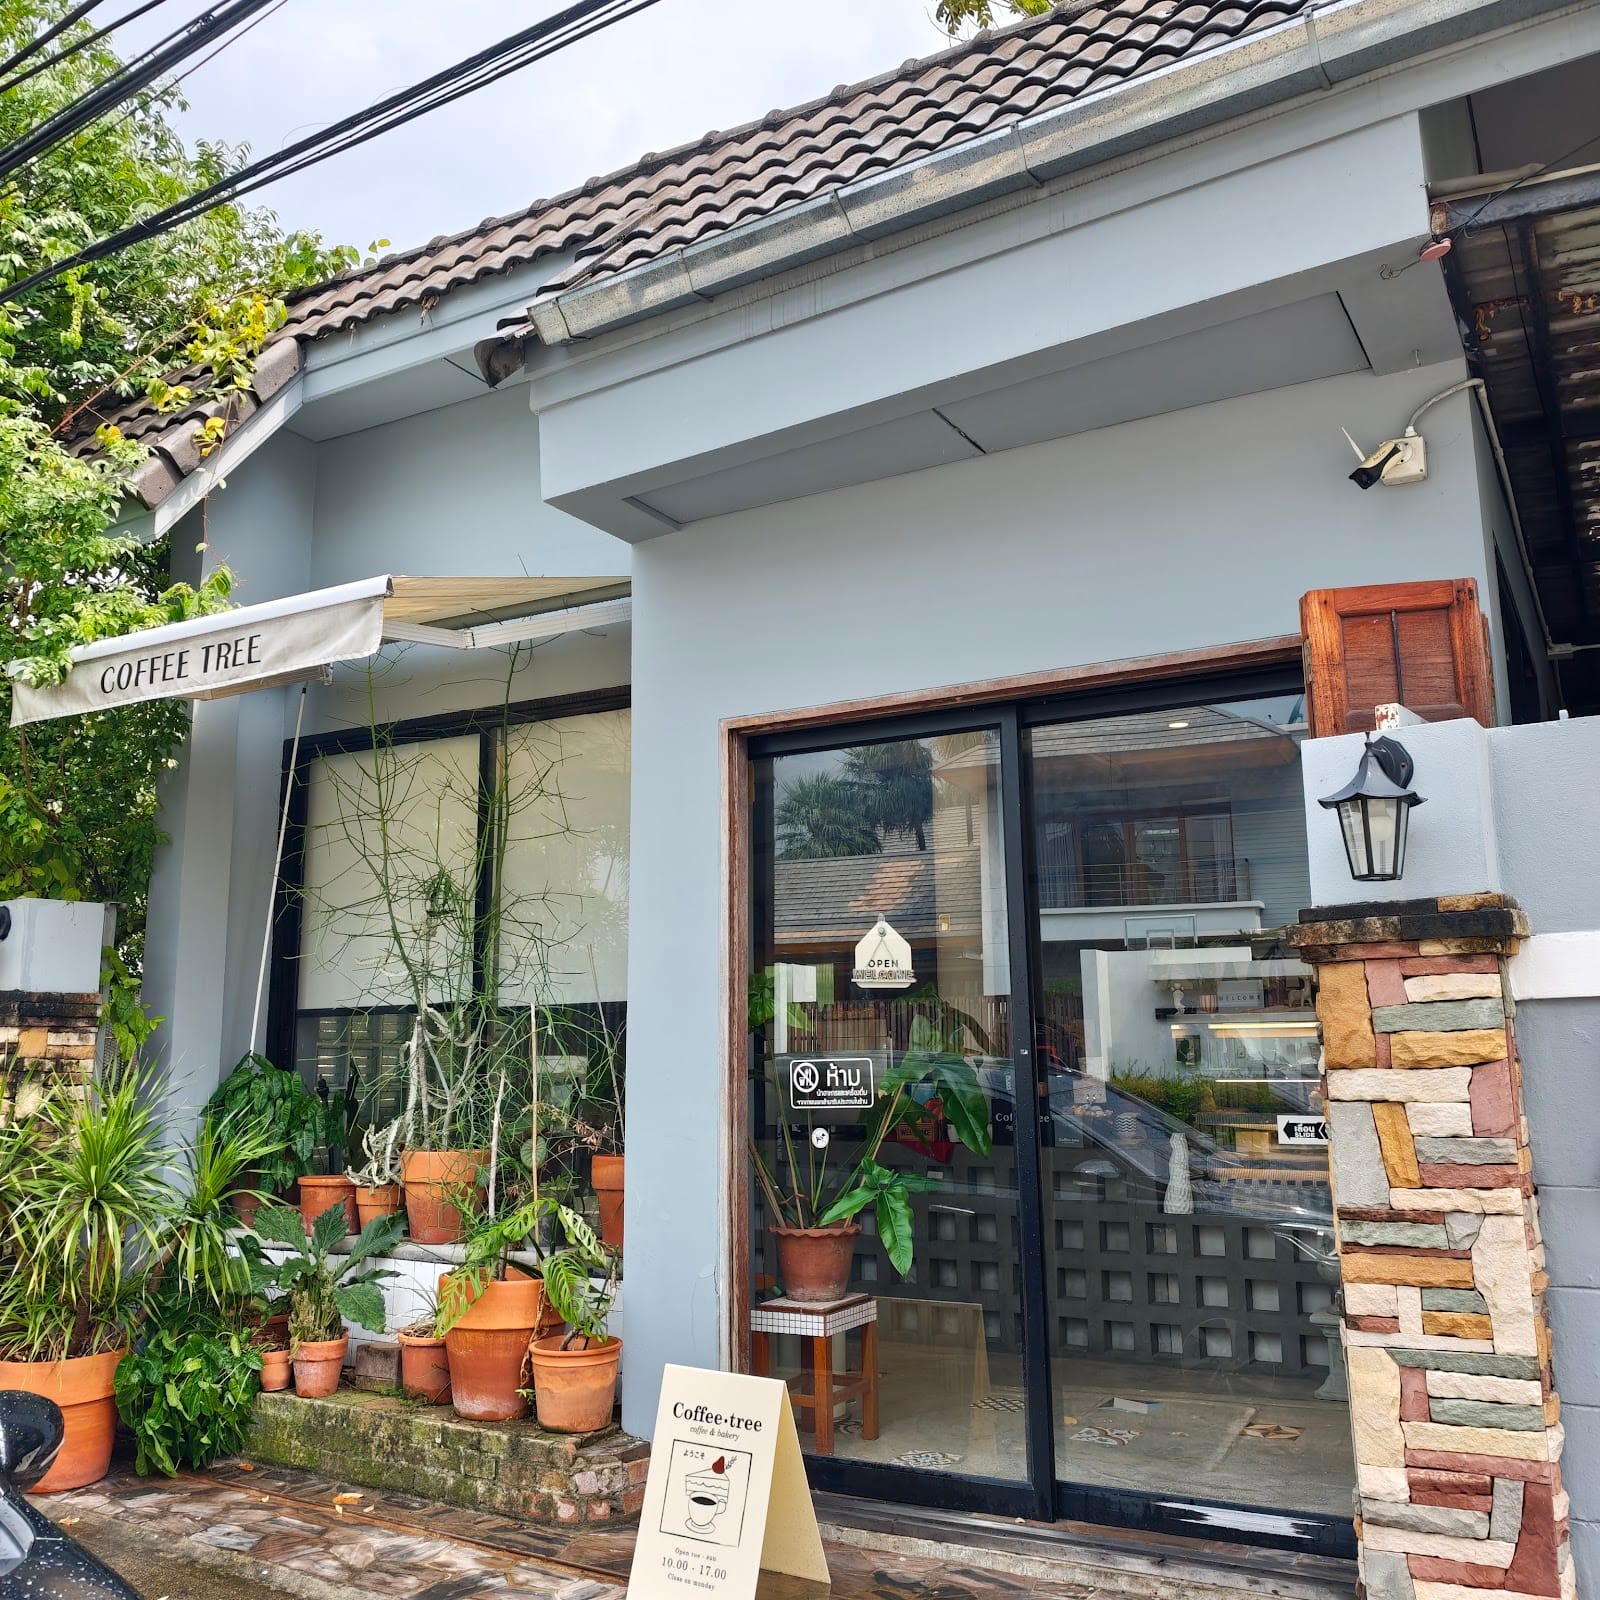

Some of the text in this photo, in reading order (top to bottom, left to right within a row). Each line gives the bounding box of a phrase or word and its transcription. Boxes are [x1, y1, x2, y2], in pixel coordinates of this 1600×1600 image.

[100, 633, 262, 694] COFFEE TREE
[868, 959, 899, 968] OPEN
[853, 968, 915, 980] WELCOME
[826, 1062, 861, 1087] ห้าม
[689, 1424, 740, 1442] coffee & bakery
[683, 1448, 705, 1460] ようこそ
[674, 1547, 690, 1556] Open
[662, 1556, 689, 1571] 10.00
[699, 1564, 727, 1580] 17.00
